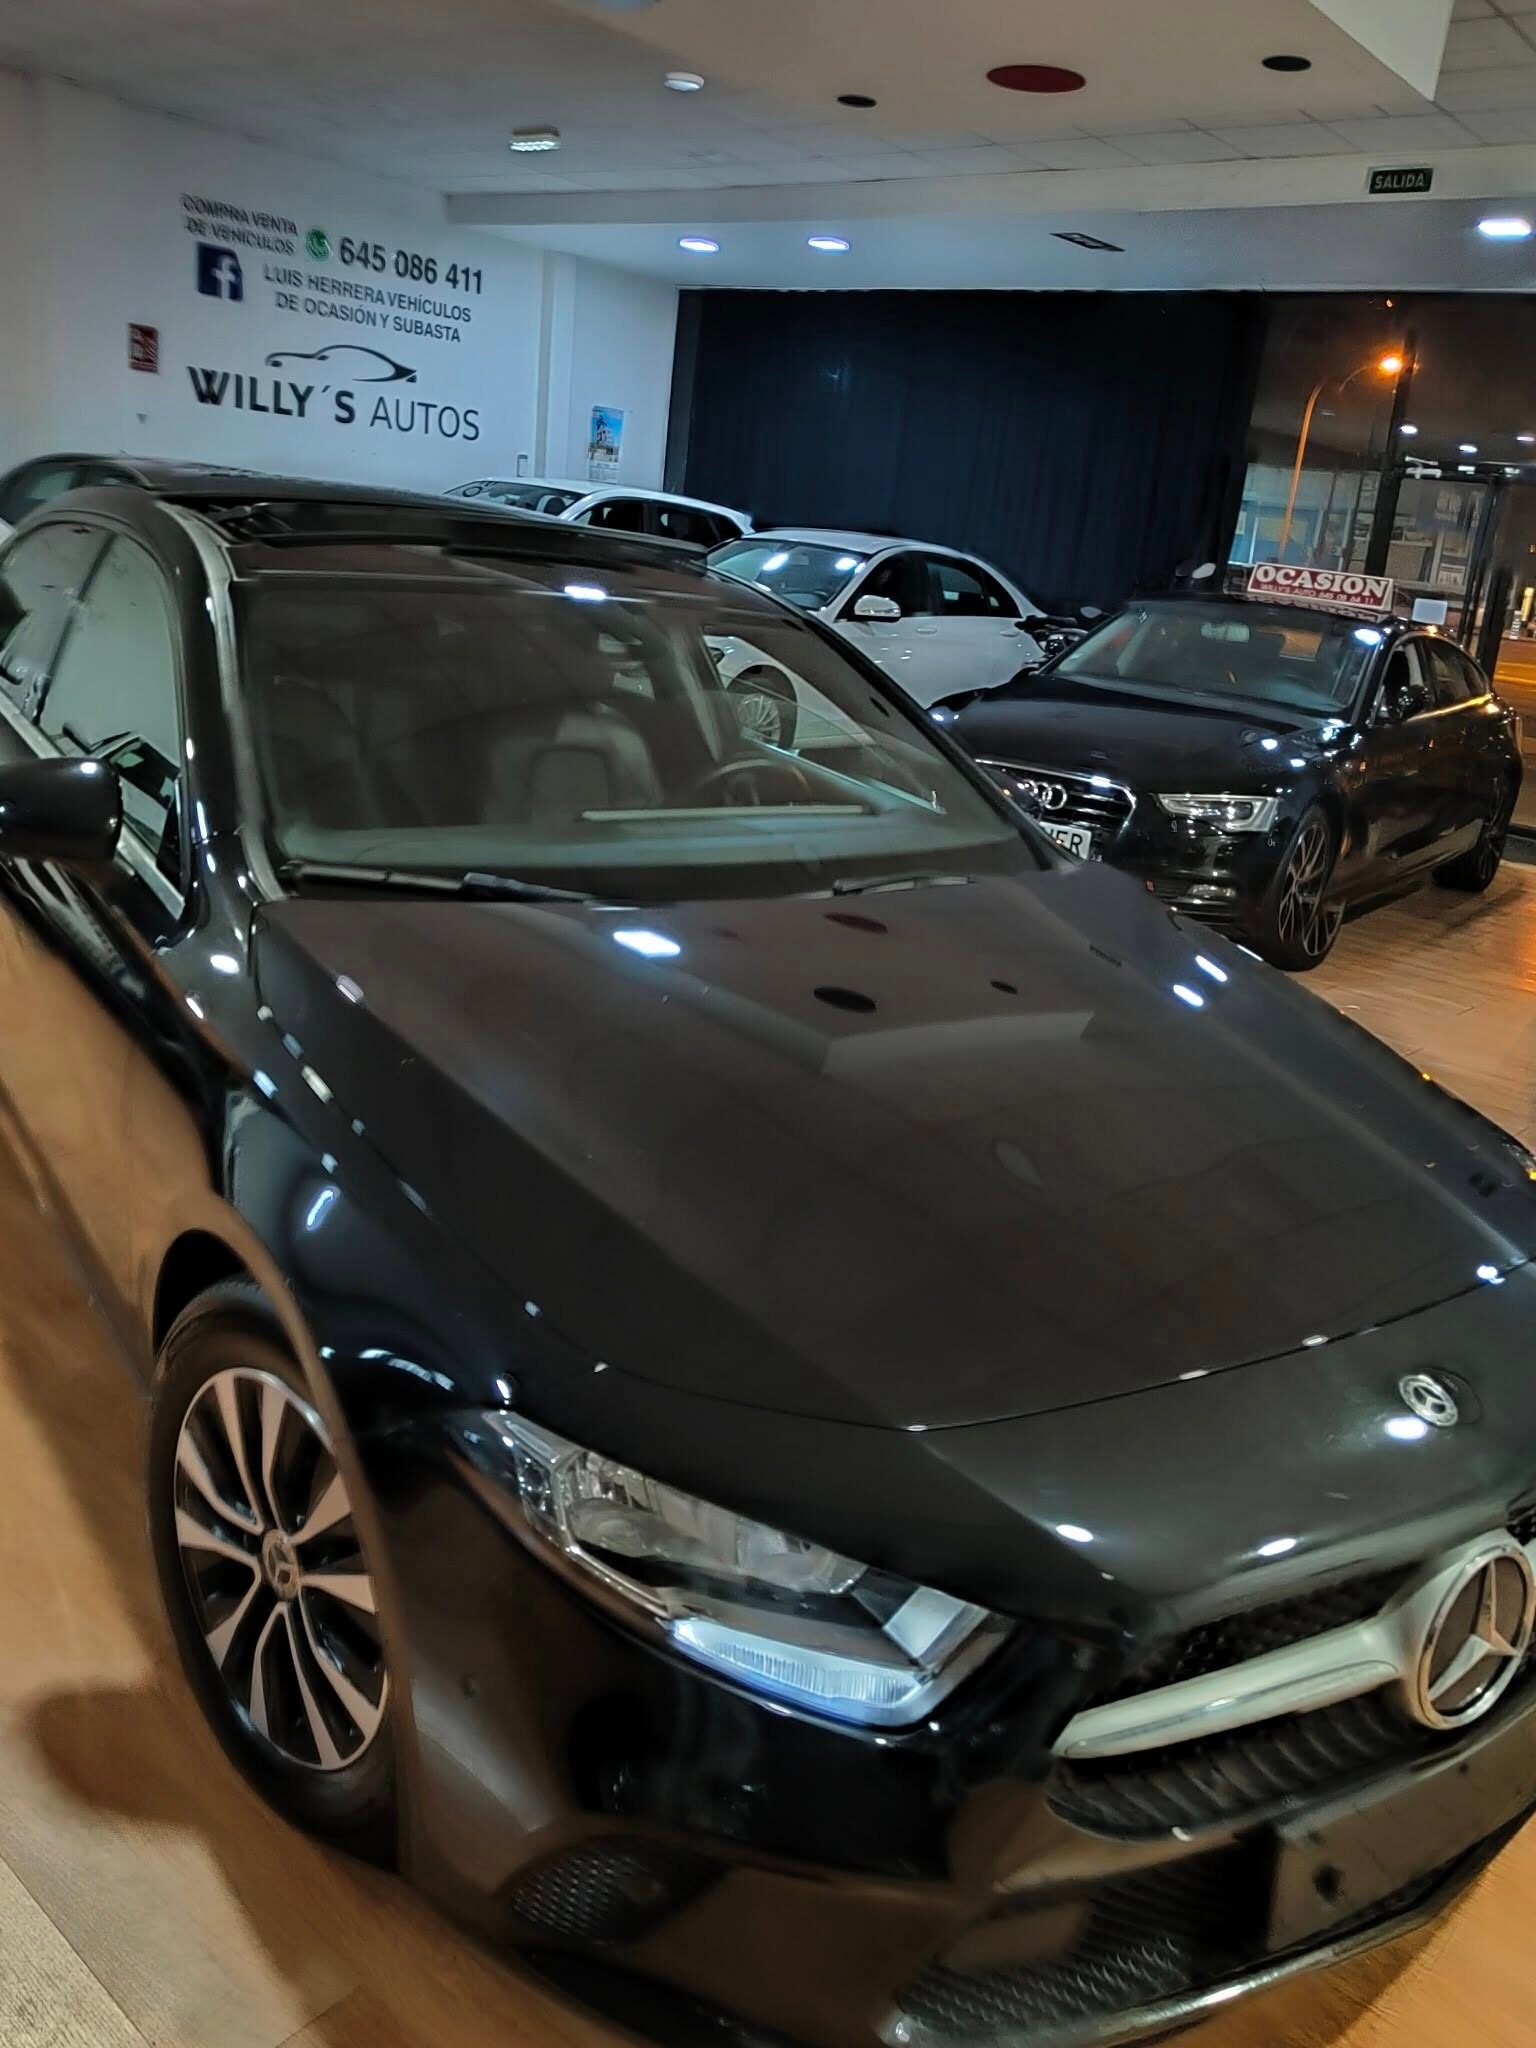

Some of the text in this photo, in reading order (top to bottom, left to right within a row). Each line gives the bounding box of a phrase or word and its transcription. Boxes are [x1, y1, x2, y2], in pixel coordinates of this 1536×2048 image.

[1375, 173, 1424, 189] SALIDA
[340, 236, 482, 295] 645 086 411
[264, 264, 472, 323] LUIS HERRERA VEHÍCULOS
[276, 291, 461, 343] DE OCASIÓN Y SUBASTA
[370, 396, 480, 441] AUTOS
[1256, 566, 1388, 598] OCASION
